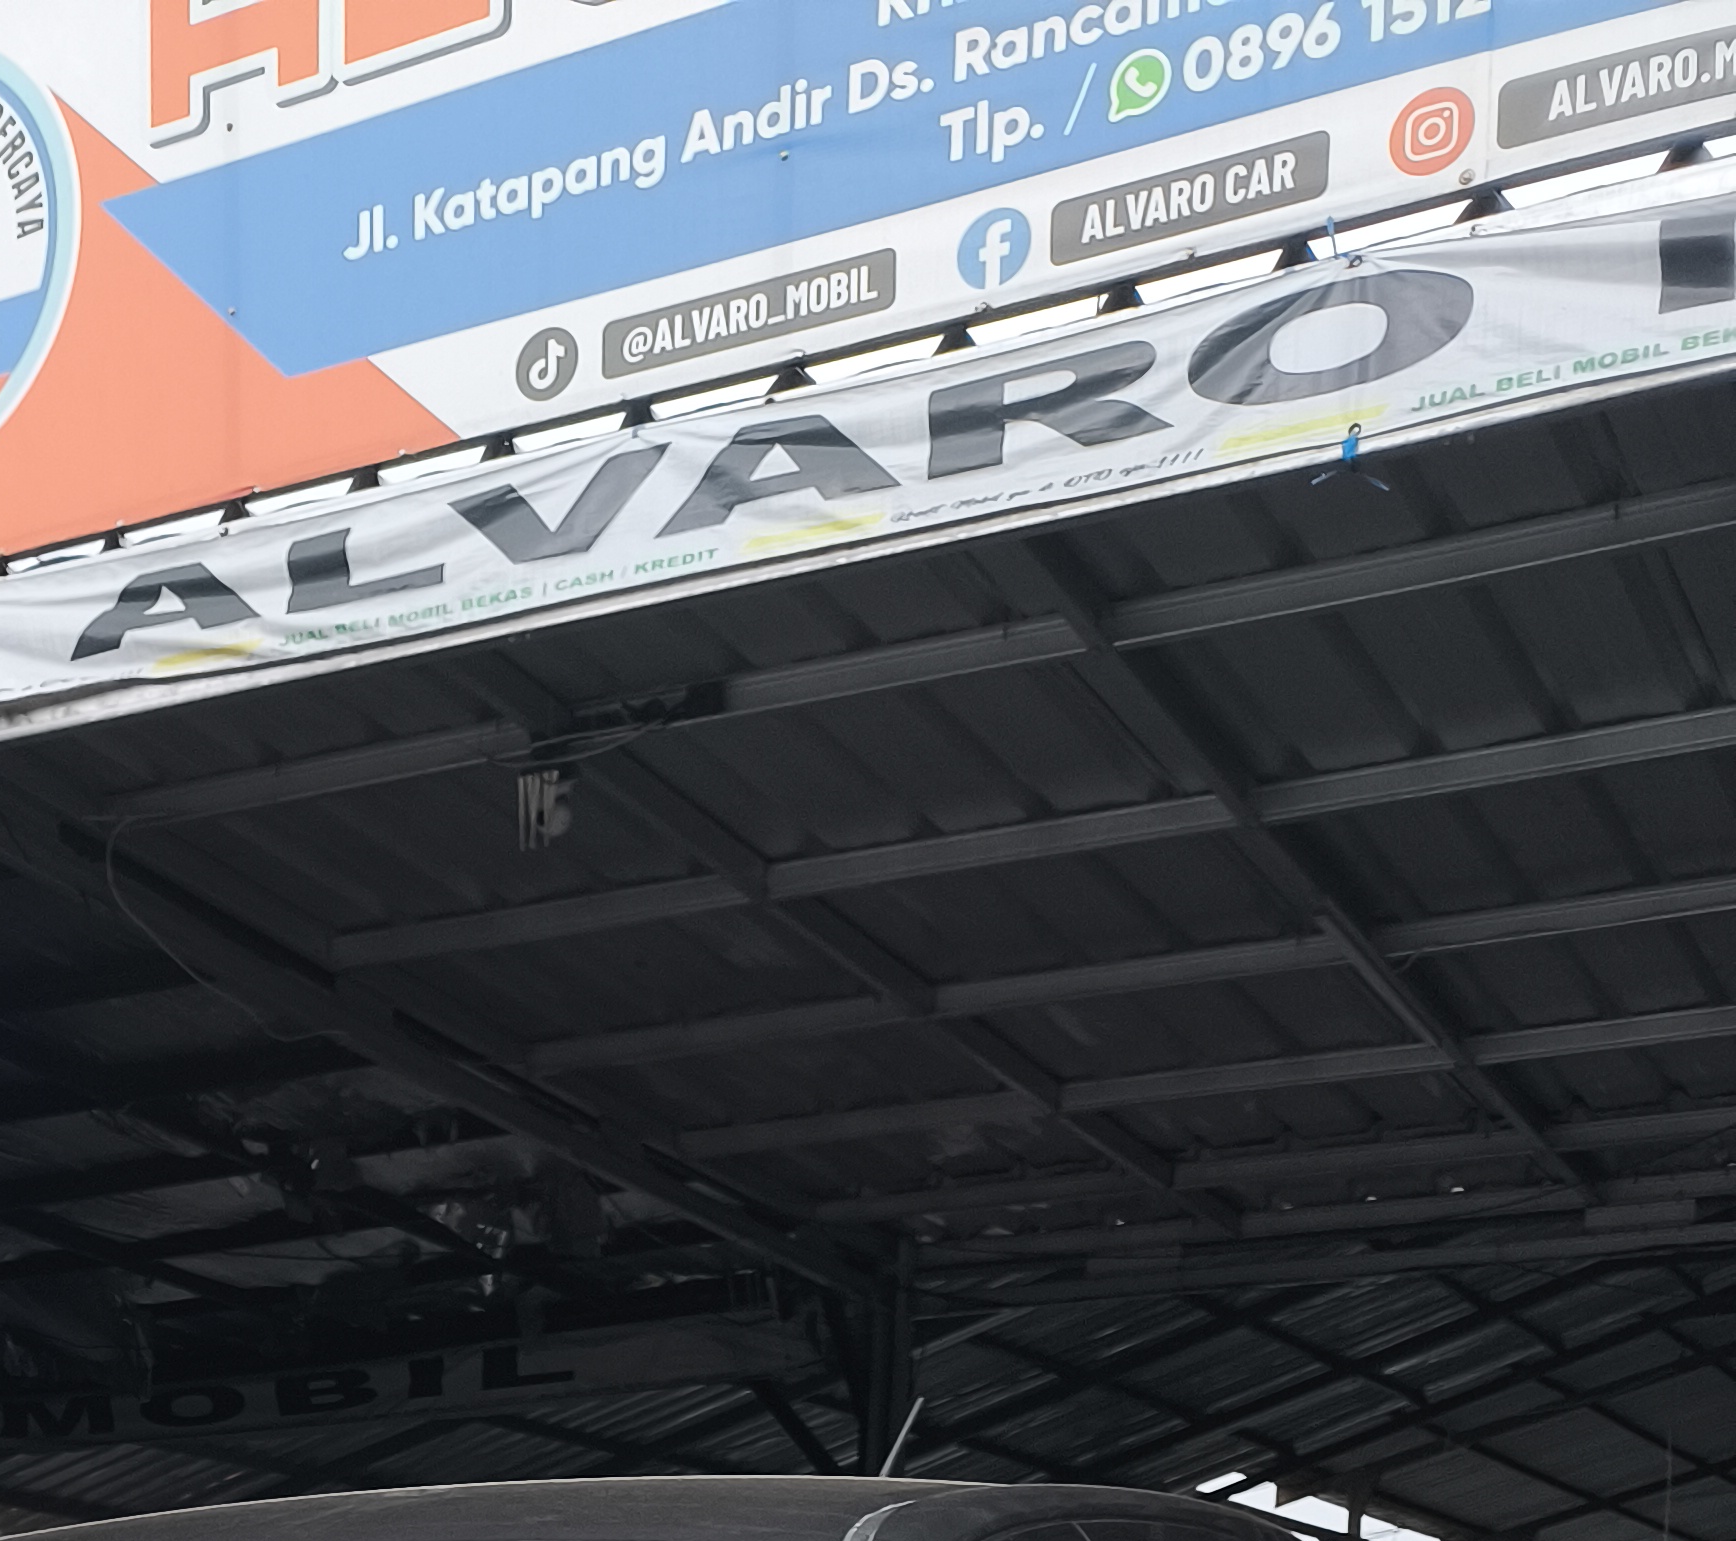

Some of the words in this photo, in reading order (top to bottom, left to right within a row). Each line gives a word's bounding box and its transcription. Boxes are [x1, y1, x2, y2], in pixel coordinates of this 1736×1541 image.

[940, 99, 1045, 163] Tlp.
[1183, 1, 1341, 94] 0896
[342, 204, 398, 260] Jl.
[413, 135, 666, 241] Katapang
[680, 78, 832, 164] Andir
[848, 58, 934, 116] Ds.
[1080, 168, 1214, 245] ALVARO
[1223, 151, 1298, 207] CAR
[622, 265, 879, 363] @ALVARO_MOBIL
[1411, 383, 1486, 412] JUAL
[1495, 365, 1561, 393] BELI
[1572, 342, 1671, 375] MOBIL
[70, 266, 1476, 662] ALVARO
[554, 569, 615, 592] CASH
[633, 547, 720, 575] KREDIT
[0, 1347, 576, 1441] MOBIL
